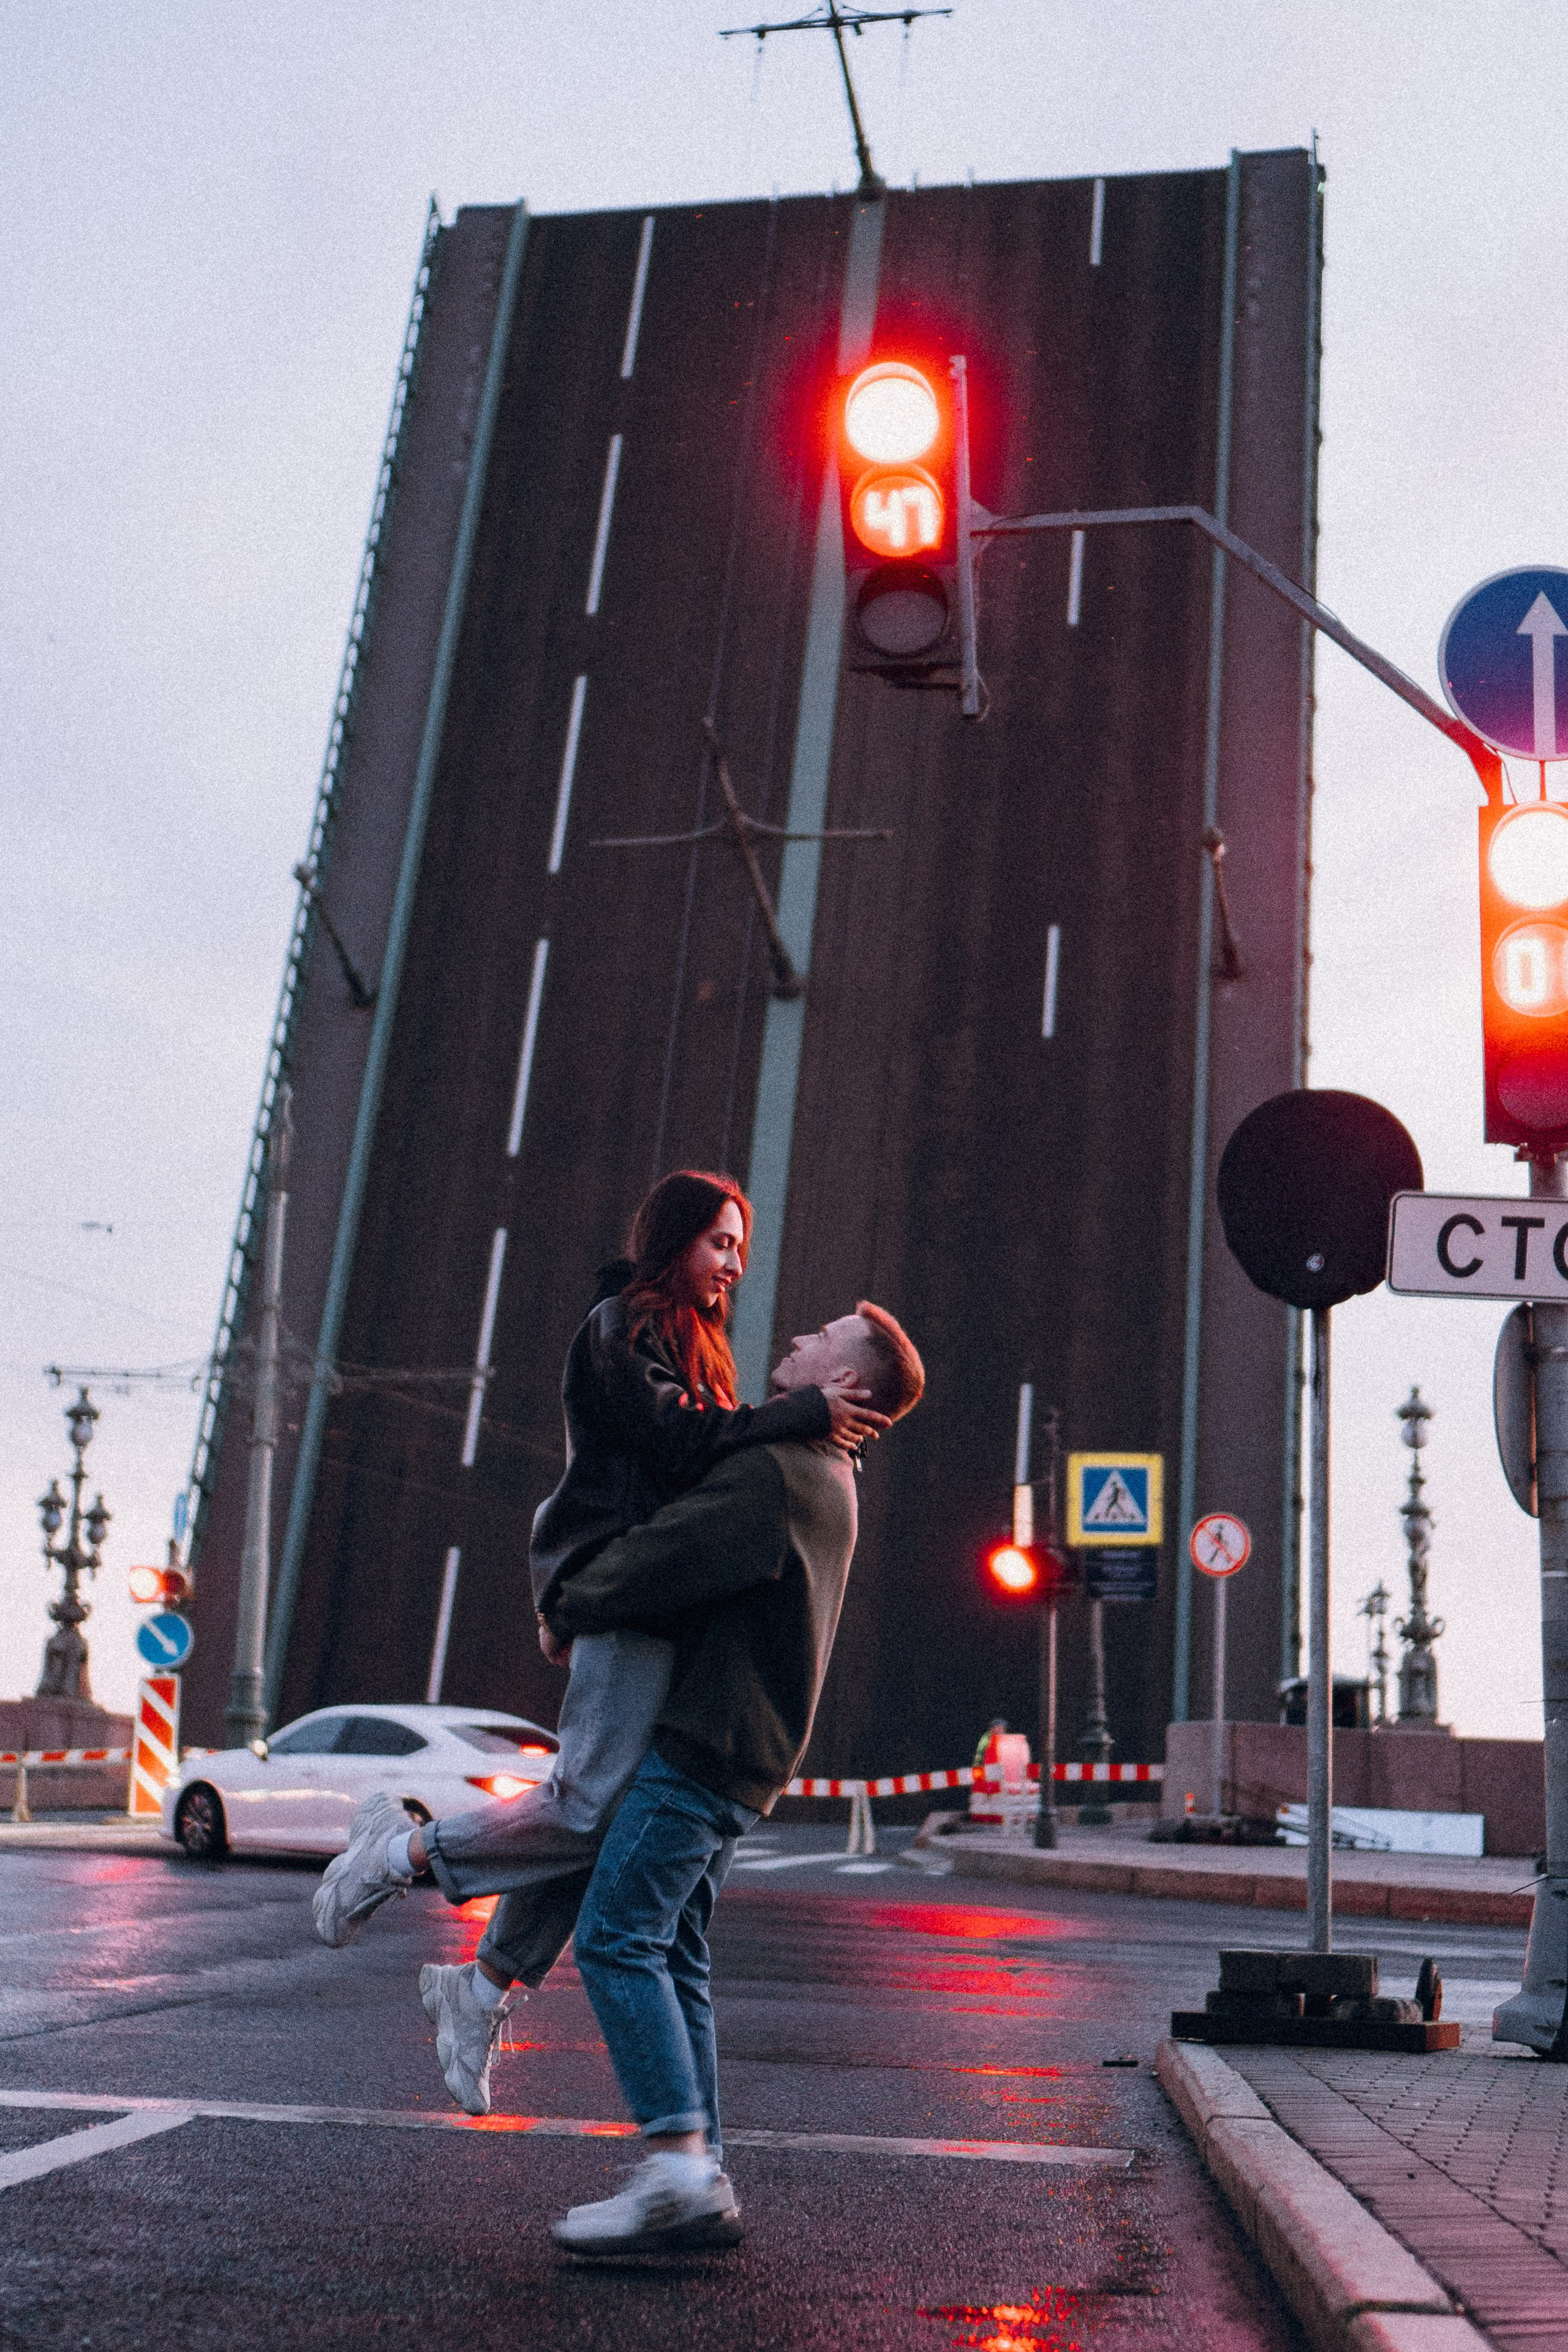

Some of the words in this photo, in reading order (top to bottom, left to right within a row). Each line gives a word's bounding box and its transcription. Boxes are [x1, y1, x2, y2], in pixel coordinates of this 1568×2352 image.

[865, 487, 937, 546] 47
[1506, 938, 1568, 1003] 0
[1437, 1213, 1568, 1280] СТ
